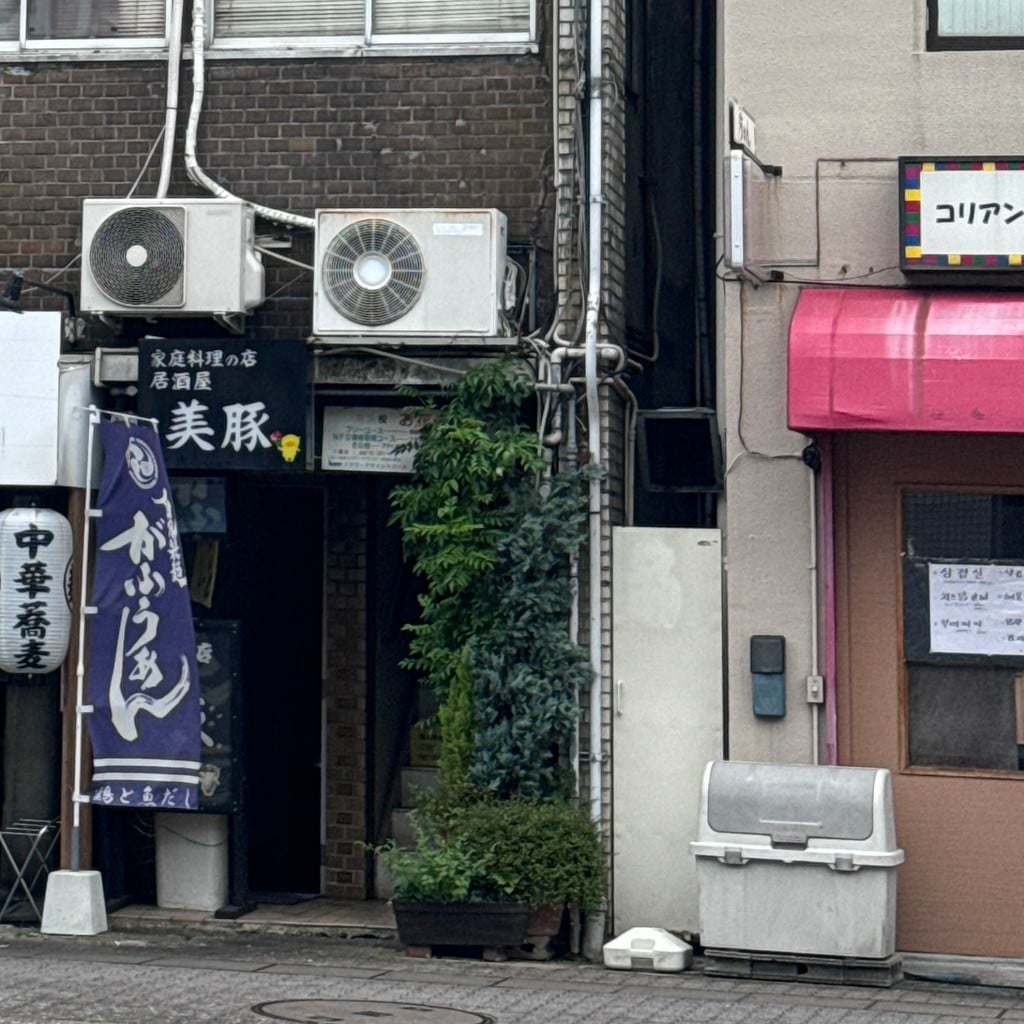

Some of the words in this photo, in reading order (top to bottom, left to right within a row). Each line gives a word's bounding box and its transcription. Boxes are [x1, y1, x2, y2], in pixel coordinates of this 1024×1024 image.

[936, 202, 1024, 224] コリアン
[150, 348, 258, 369] 家庭料理の店
[150, 371, 213, 391] 居酒屋
[165, 398, 272, 453] 美豚
[13, 522, 55, 669] 中華蕎麦
